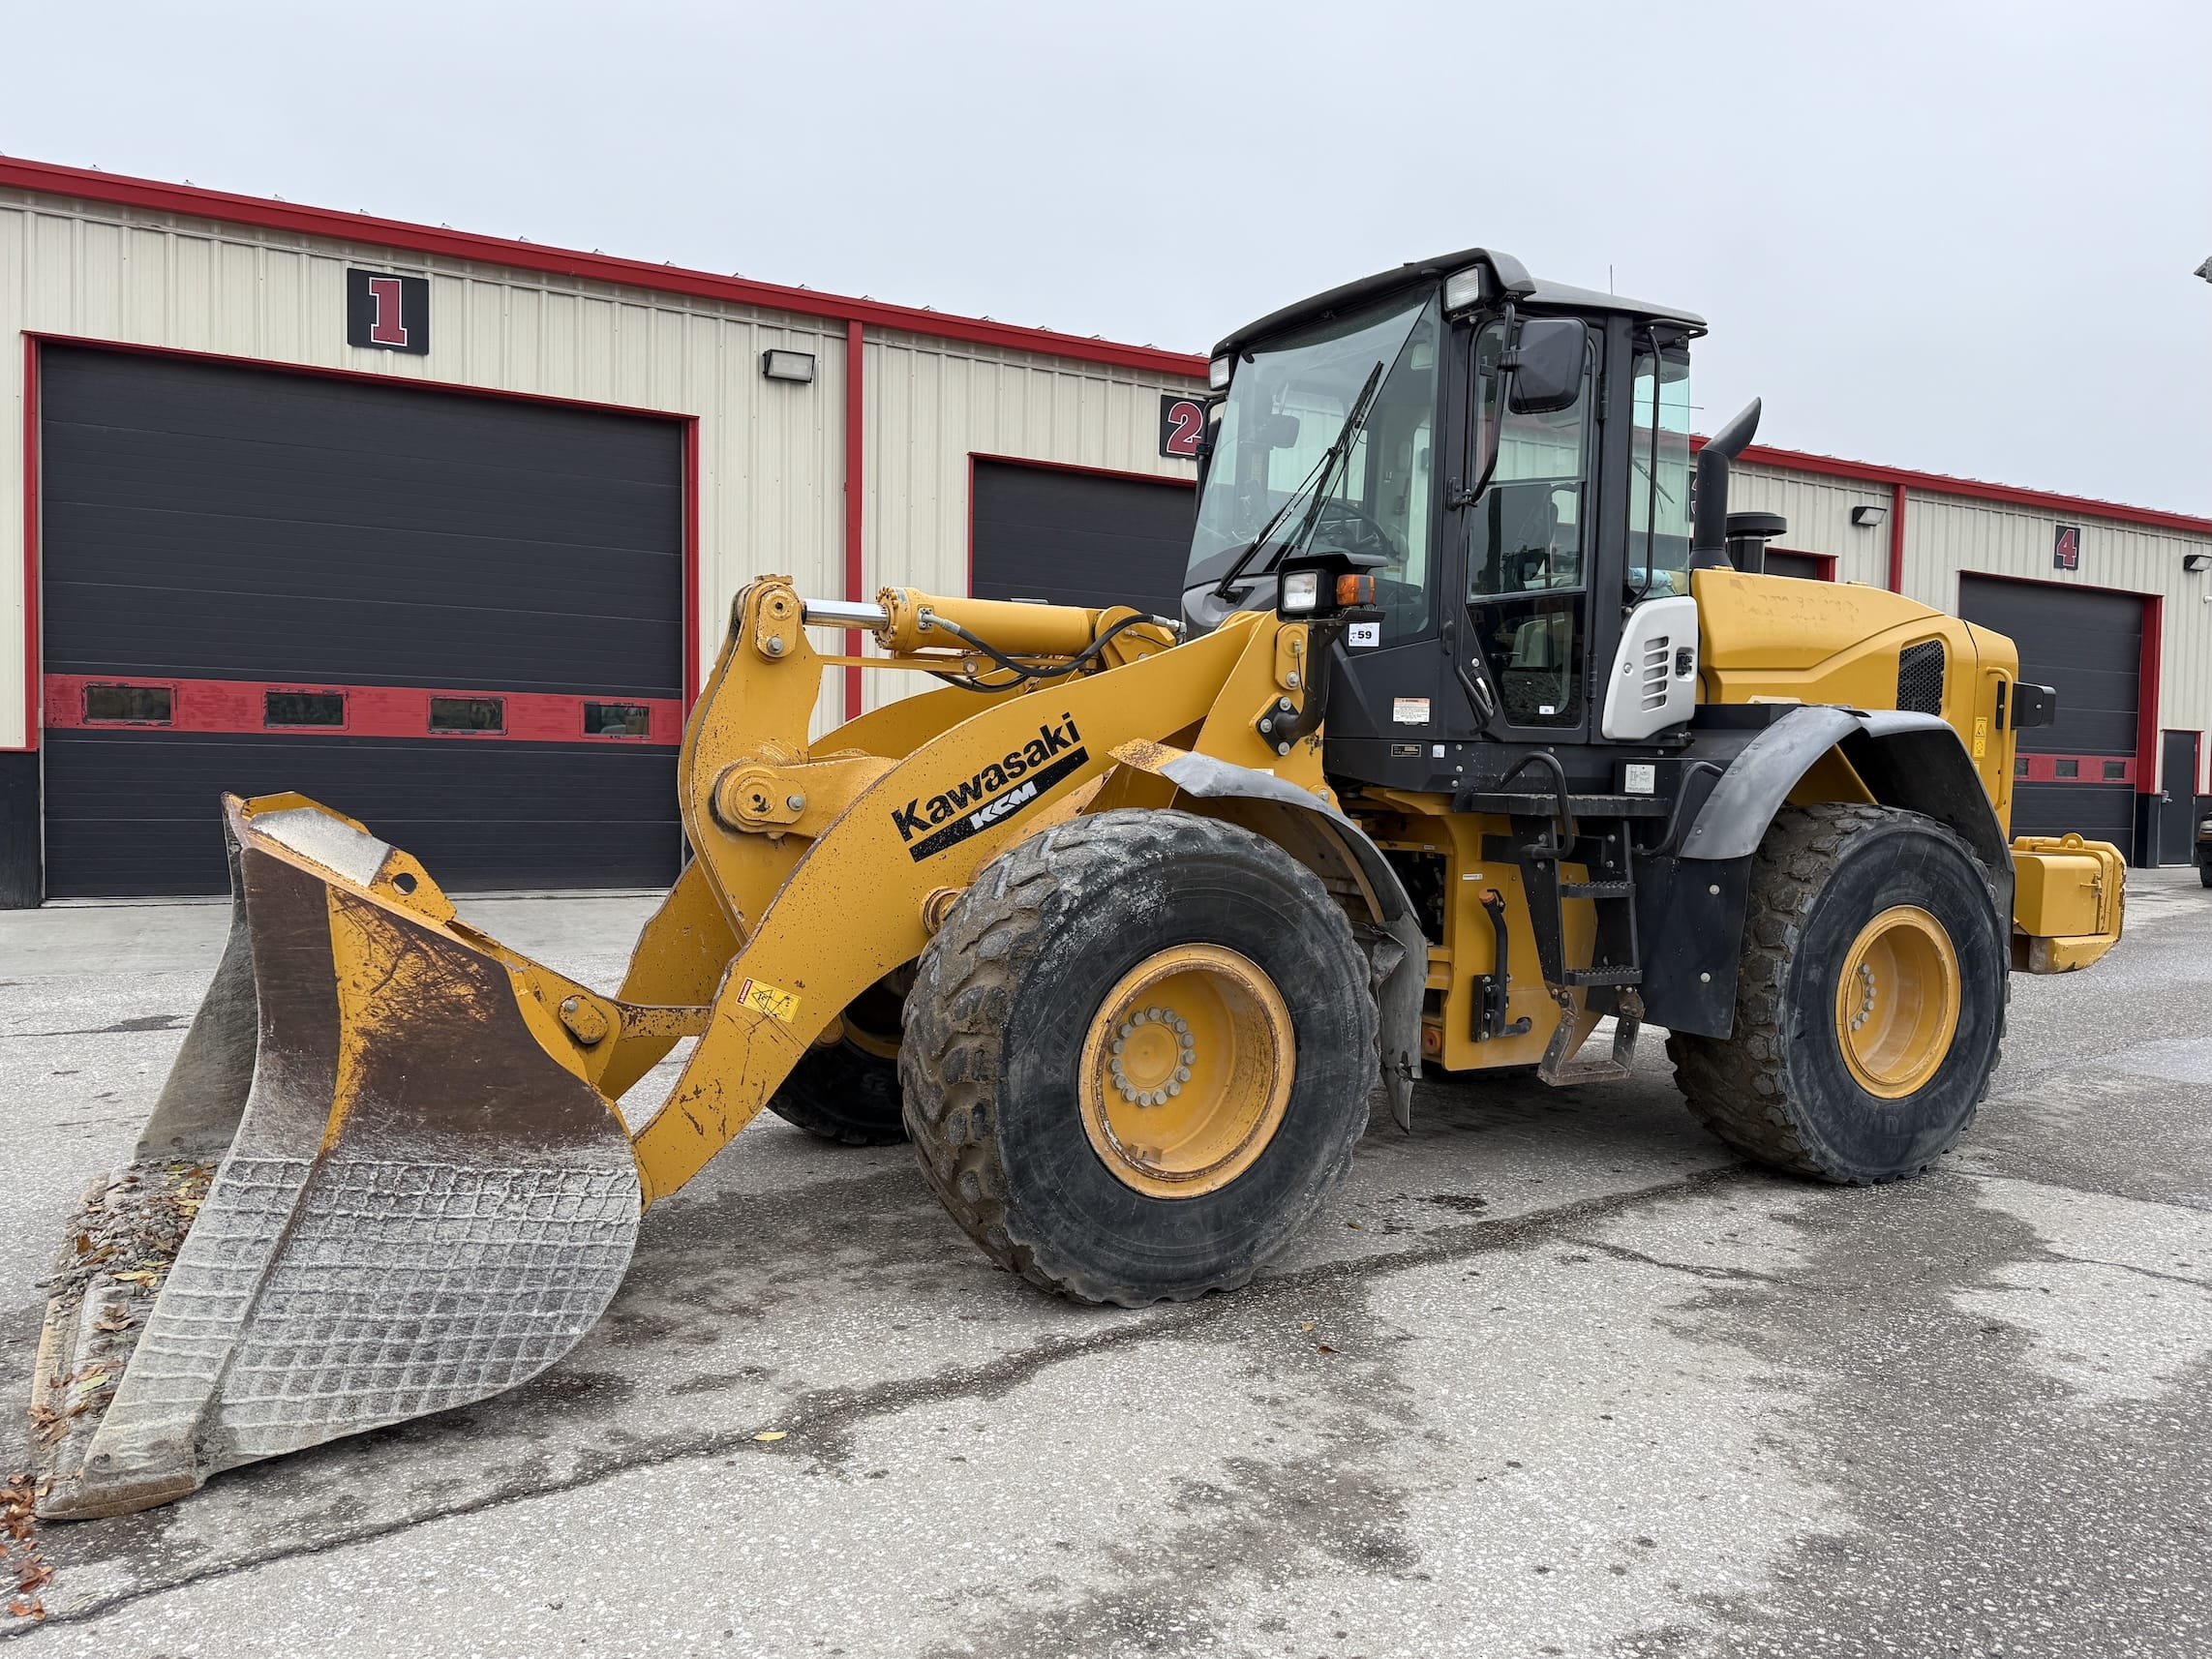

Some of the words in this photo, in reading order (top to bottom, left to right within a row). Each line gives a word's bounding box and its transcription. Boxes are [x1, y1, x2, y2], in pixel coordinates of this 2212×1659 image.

[369, 277, 408, 347] 1
[1167, 401, 1203, 456] 2
[2056, 528, 2077, 566] 4
[1357, 630, 1372, 640] 59
[891, 711, 1081, 843] Kawasaki
[968, 780, 1038, 830] KCM
